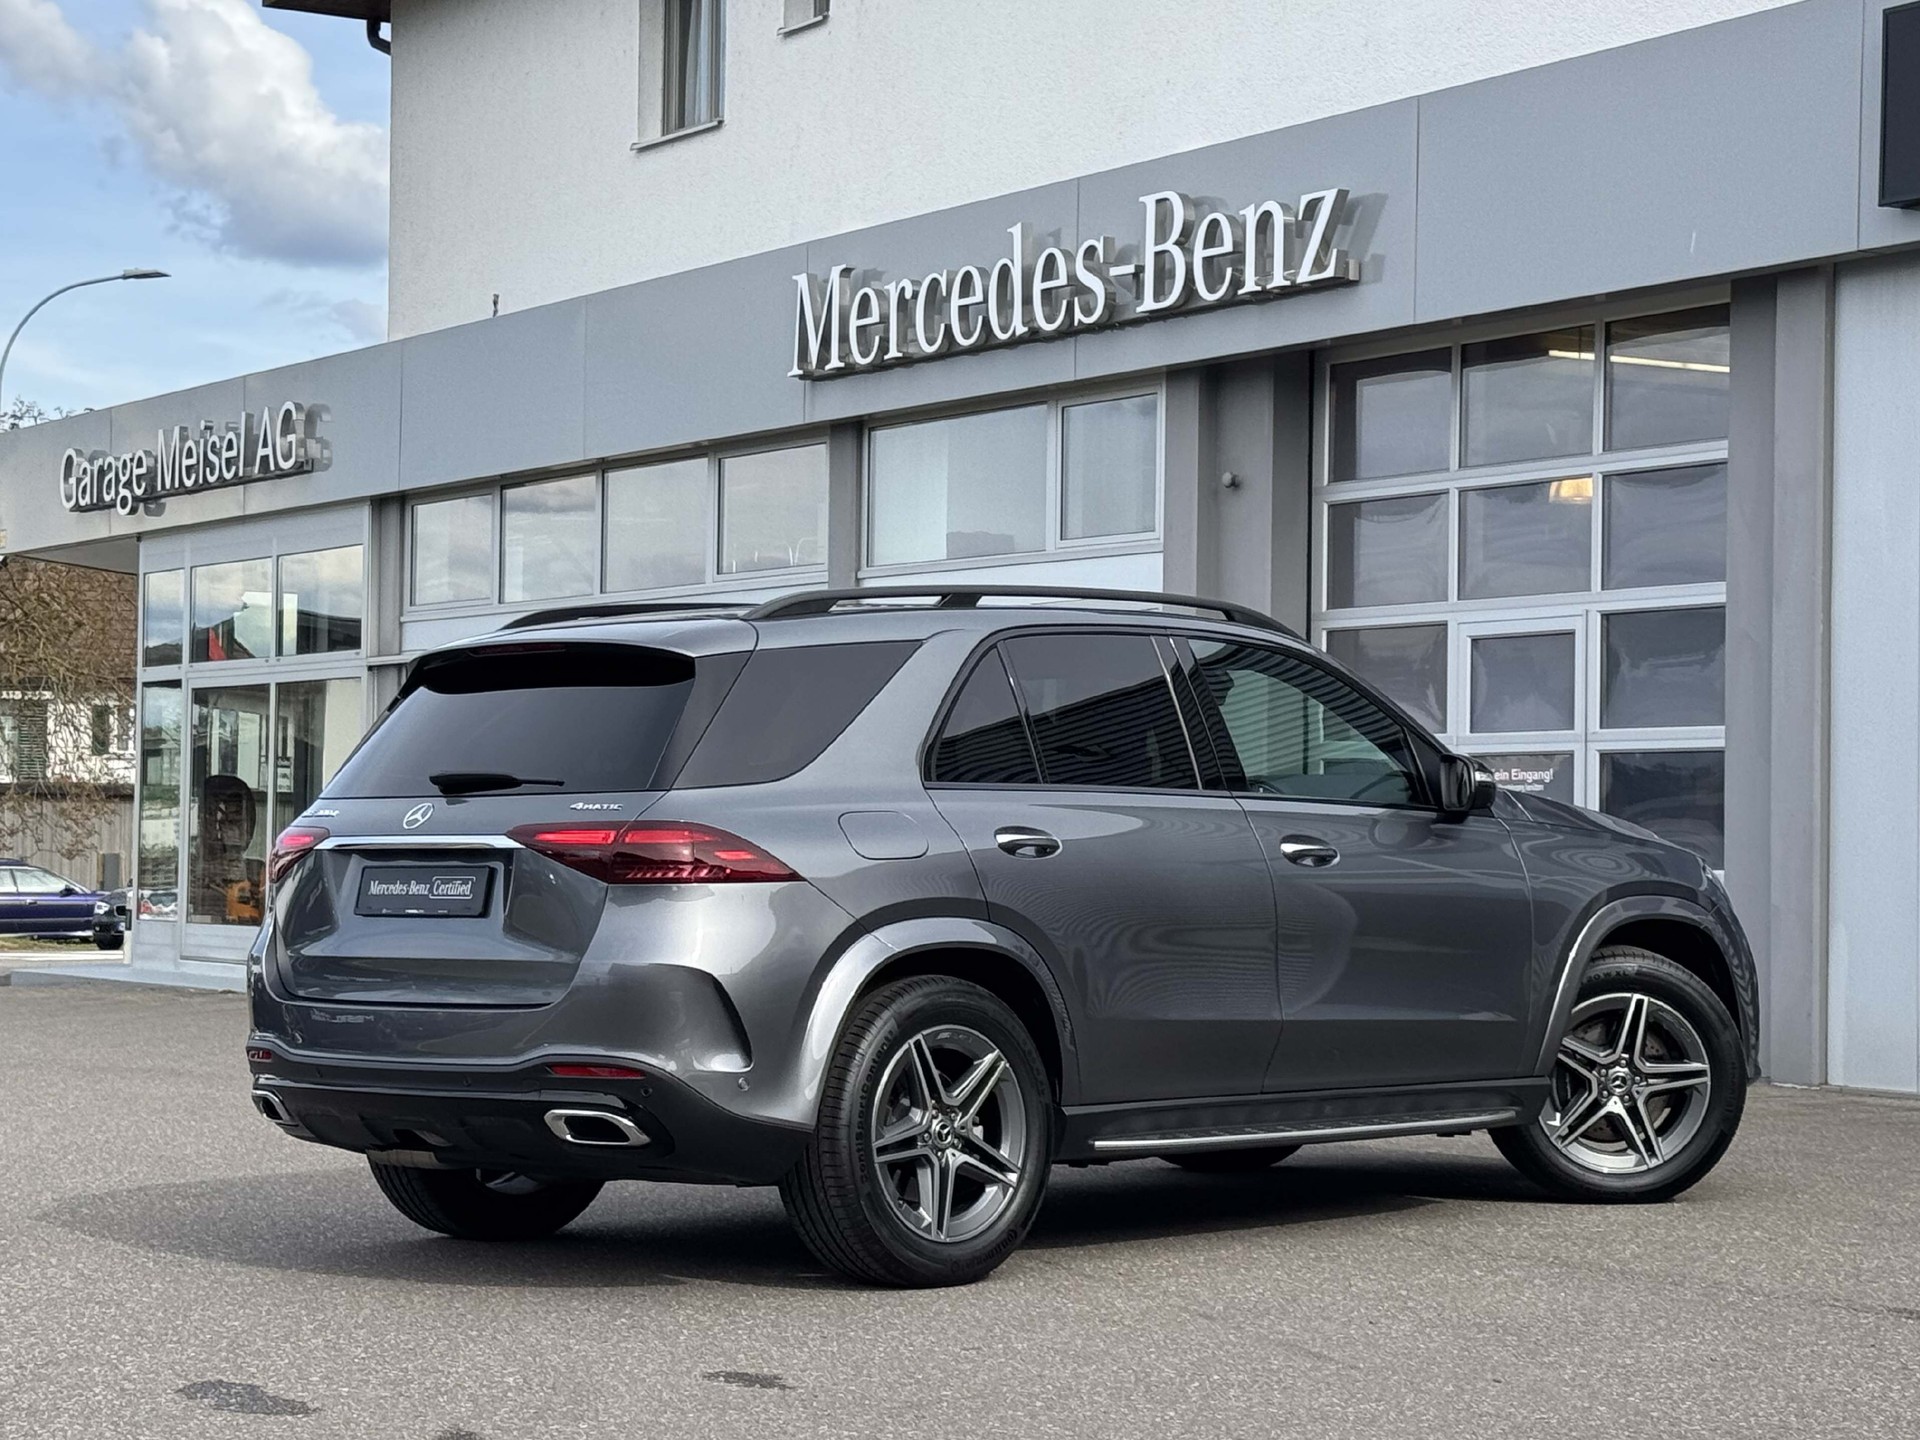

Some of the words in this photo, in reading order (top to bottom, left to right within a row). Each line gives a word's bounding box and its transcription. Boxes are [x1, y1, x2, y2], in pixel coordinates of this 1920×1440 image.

[787, 188, 1350, 377] Mercedes-Benz
[59, 447, 147, 515] Garage
[157, 411, 246, 491] Meisel
[254, 401, 299, 474] AG
[1491, 769, 1509, 780] ein
[1511, 768, 1554, 783] Eingang!
[569, 802, 624, 810] 4MATIC
[368, 880, 431, 895] Mercedes-Benz
[432, 880, 472, 895] Certified
